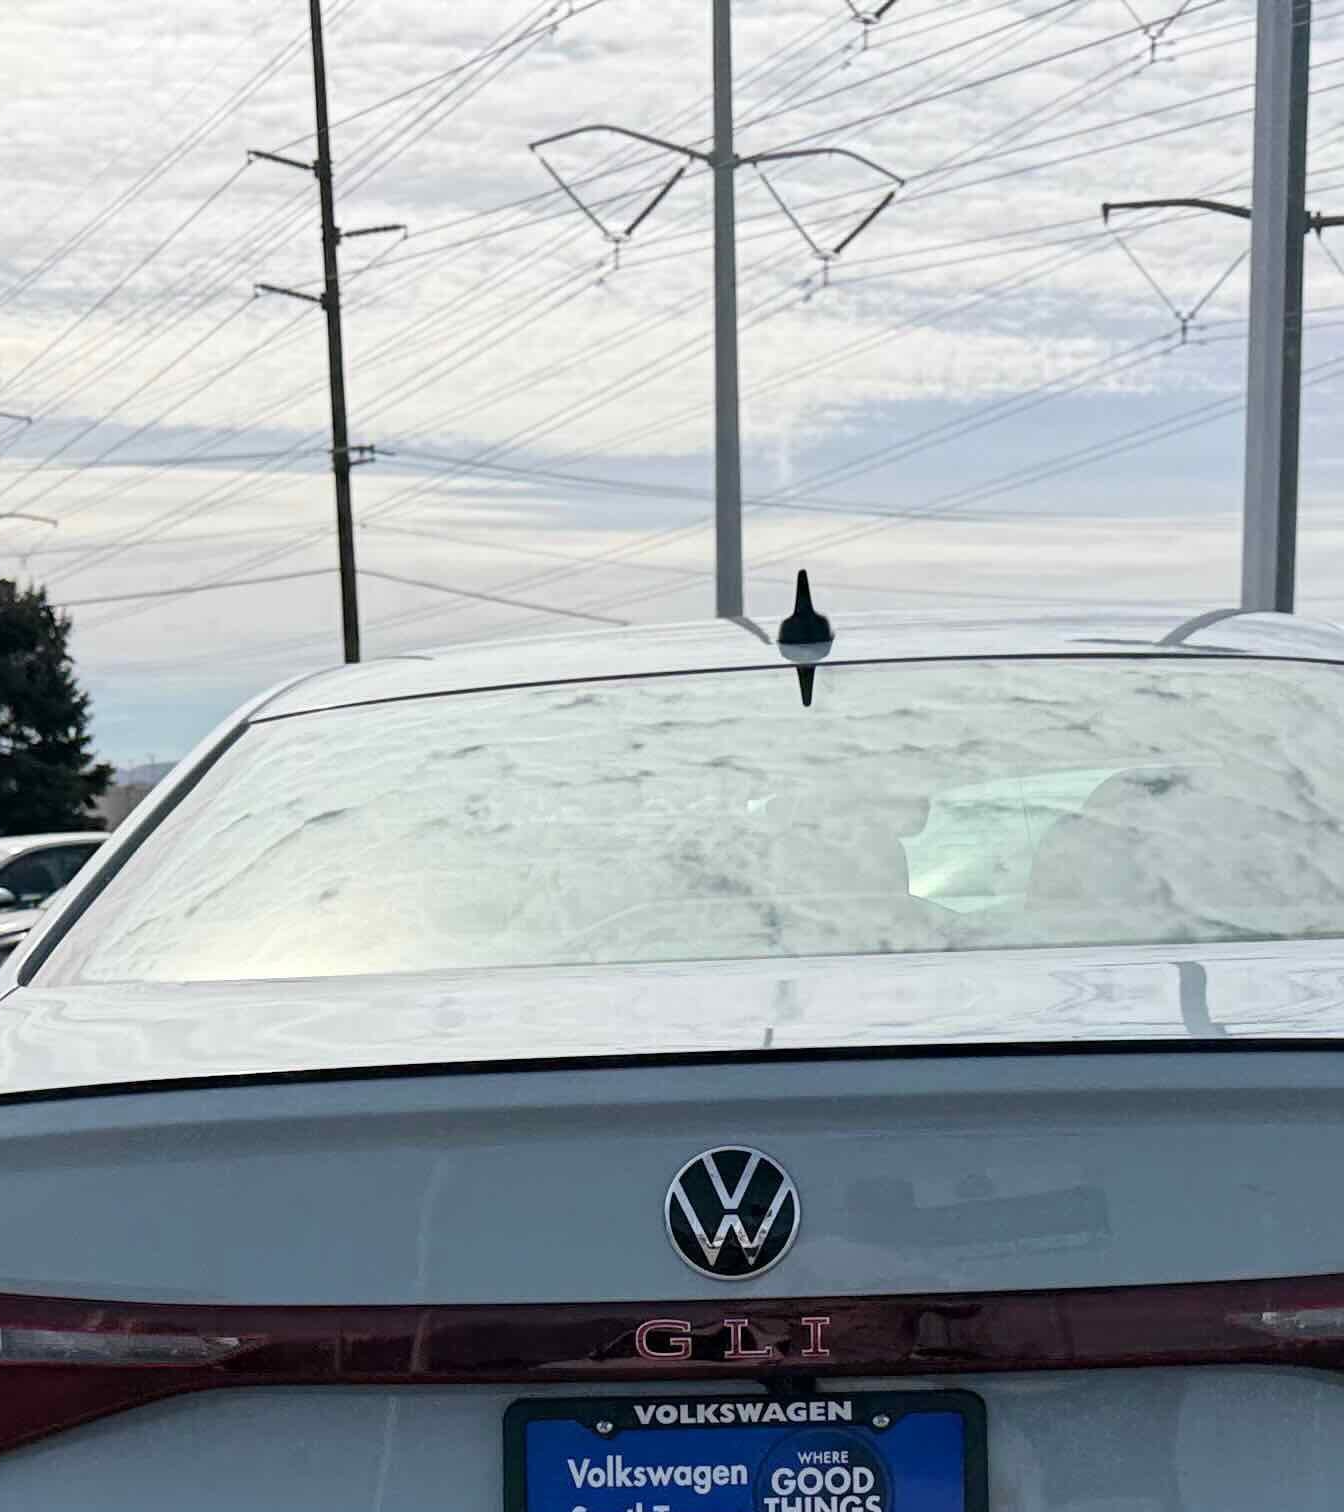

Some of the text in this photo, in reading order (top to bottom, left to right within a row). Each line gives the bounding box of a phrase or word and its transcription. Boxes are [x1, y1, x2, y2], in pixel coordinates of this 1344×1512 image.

[665, 1146, 800, 1280] VW
[635, 1316, 830, 1360] GLI
[634, 1401, 852, 1425] VOLKSWAGEN
[798, 1451, 849, 1464] WHERE
[568, 1456, 748, 1494] Volkswagen
[771, 1467, 875, 1495] GOOD
